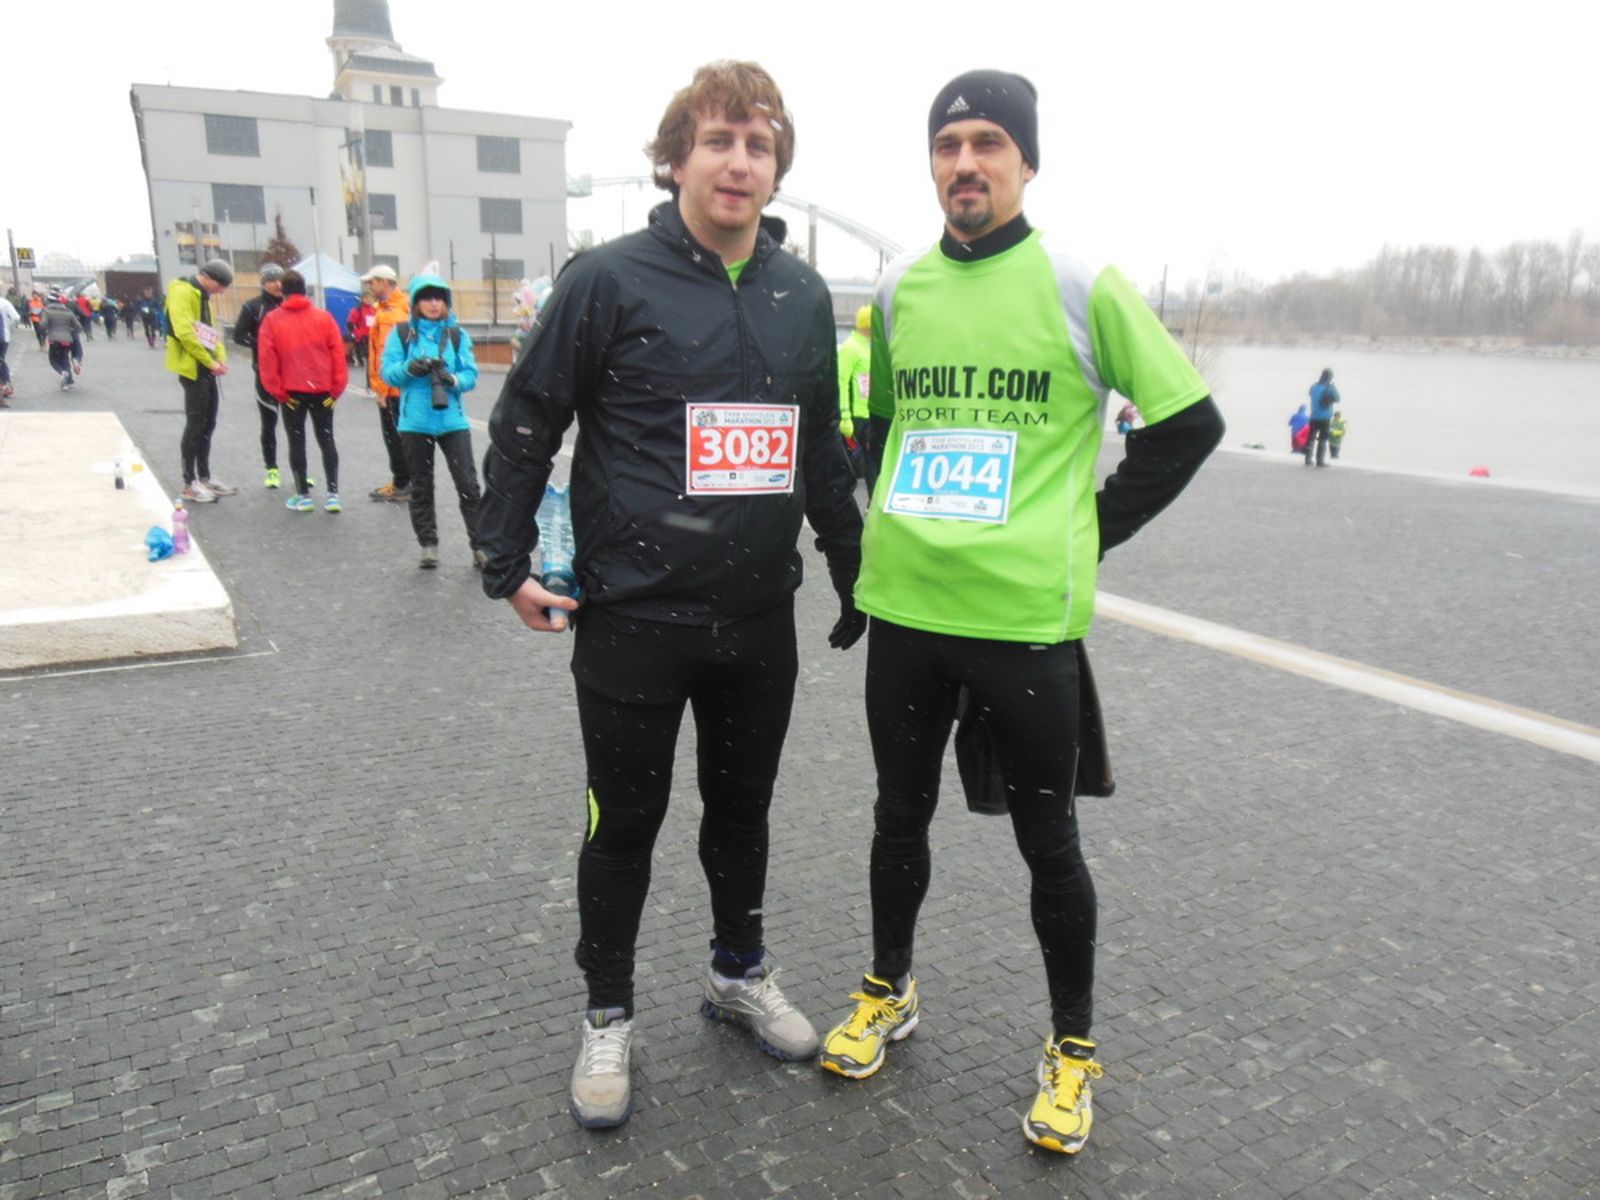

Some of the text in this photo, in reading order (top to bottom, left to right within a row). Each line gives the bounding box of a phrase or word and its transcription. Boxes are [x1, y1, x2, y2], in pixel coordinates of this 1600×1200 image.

[899, 407, 1048, 425] SPORT TEAM
[699, 429, 788, 465] 3082
[910, 455, 1002, 493] 1044
